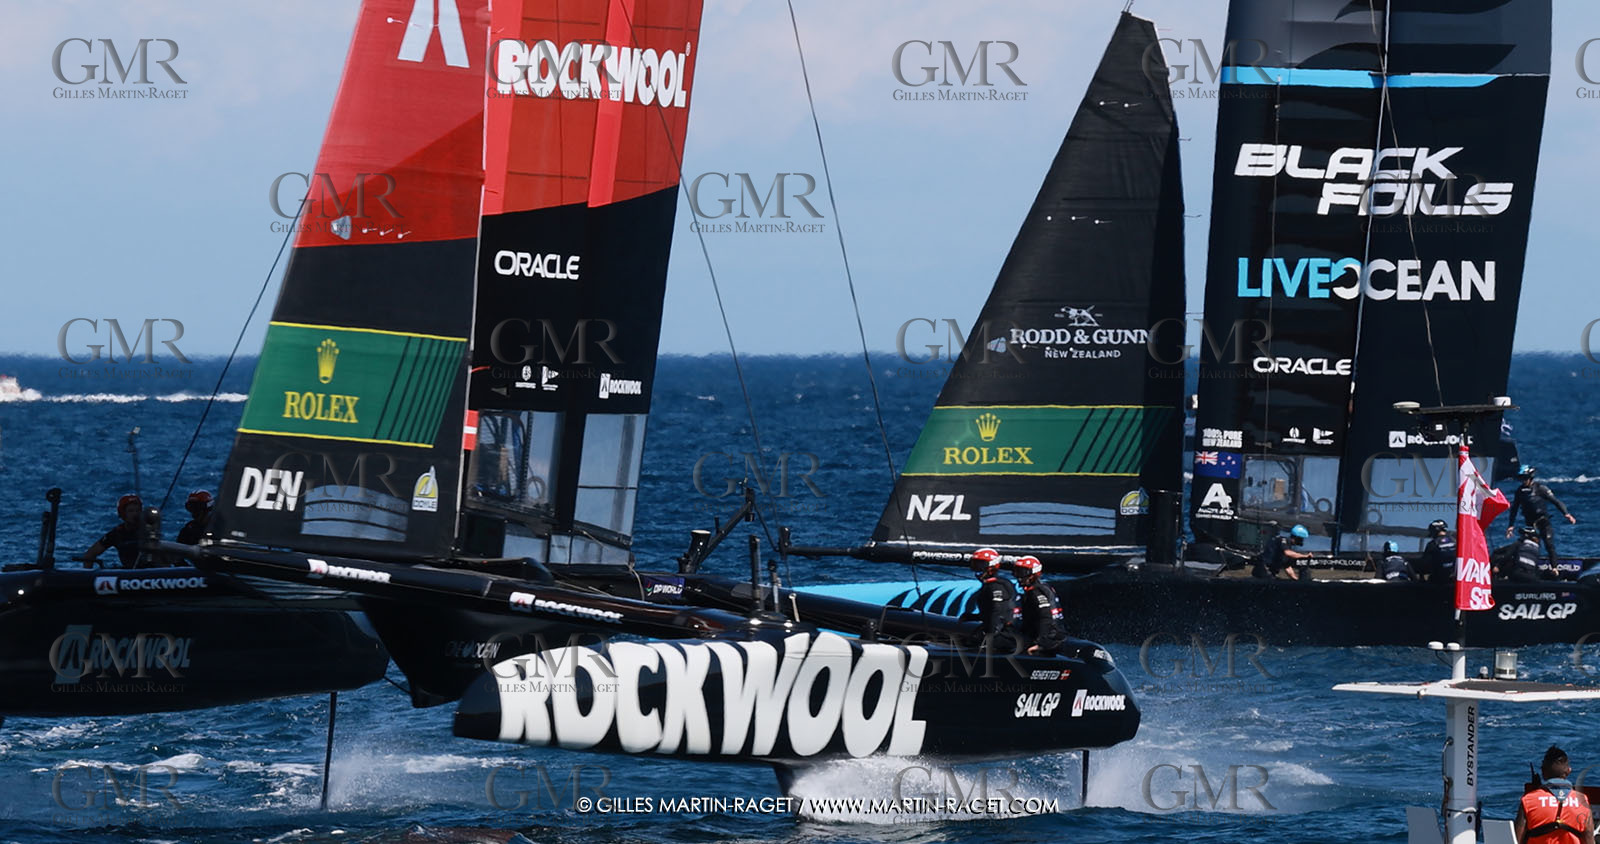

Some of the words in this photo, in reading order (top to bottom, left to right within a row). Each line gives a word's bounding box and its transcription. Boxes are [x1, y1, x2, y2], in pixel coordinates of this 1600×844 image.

[1234, 143, 1464, 180] BLACK
[1317, 182, 1514, 216] FOILS
[494, 250, 580, 280] ORACLE
[1010, 329, 1071, 344] RODD
[1073, 329, 1091, 344] &
[1092, 329, 1153, 344] GUNN
[1045, 350, 1068, 359] NEW
[1072, 350, 1121, 359] ZEALAND
[1252, 357, 1352, 376] ORACLE
[609, 380, 642, 394] ROCKWOOL
[282, 391, 360, 423] ROLEX
[942, 447, 1034, 465] ROLEX
[235, 466, 303, 511] DEN
[906, 494, 972, 521] NZL
[913, 551, 963, 561] POWERED
[120, 577, 208, 590] ROCKWOOL
[90, 637, 192, 669] ROCKWOOL
[492, 631, 928, 758] ROCKWOOL
[1084, 695, 1126, 711] ROCKWOOL
[1467, 706, 1475, 786] BYSTANDER
